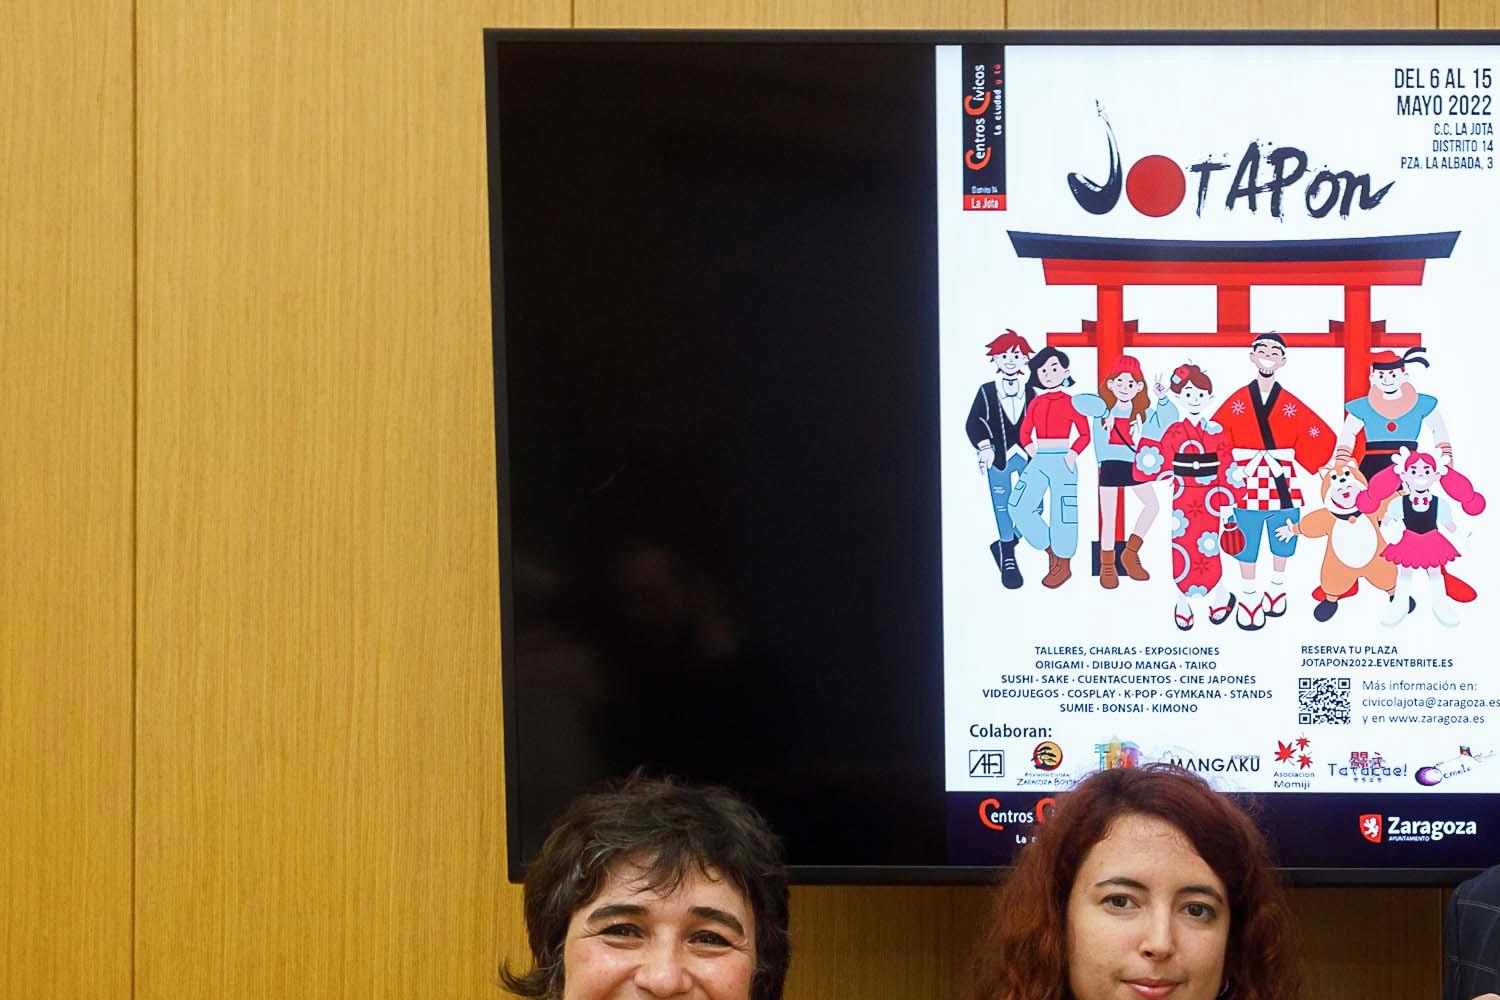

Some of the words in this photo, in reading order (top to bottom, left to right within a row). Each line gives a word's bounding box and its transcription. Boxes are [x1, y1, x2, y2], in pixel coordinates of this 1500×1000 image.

[1395, 68, 1425, 89] DEL
[1430, 68, 1440, 89] 6
[1445, 68, 1466, 89] AL
[1474, 68, 1492, 89] 15
[964, 64, 991, 116] Cívicos
[1397, 95, 1442, 116] MAYO
[1449, 95, 1492, 116] 2022
[1434, 123, 1452, 136] C.C.
[1456, 123, 1468, 136] LA
[1470, 123, 1494, 136] JOTA
[965, 118, 992, 170] Centros
[1433, 140, 1478, 152] DISTRITO
[1482, 140, 1494, 152] 14
[1401, 157, 1422, 169] PZA.
[1426, 157, 1439, 169] LA
[1441, 157, 1483, 170] ALBADA,
[1488, 157, 1493, 169] 3
[971, 198, 981, 209] La
[982, 198, 999, 209] Jota
[1302, 646, 1347, 655] RESERVA
[1349, 646, 1362, 654] TU
[1365, 646, 1398, 655] PLAZA
[1301, 659, 1453, 668] JOTAPON2022.EVENTBRITE.ES
[1363, 680, 1386, 691] Más
[1390, 680, 1457, 691] información
[1460, 683, 1477, 691] en:
[1362, 697, 1500, 710] civicolajota@zaragoza.es
[1362, 716, 1368, 725] y
[1389, 716, 1485, 726] www.zaragoza.es
[970, 724, 1052, 738] Colaboran:
[1387, 816, 1477, 841] Zaragoza
